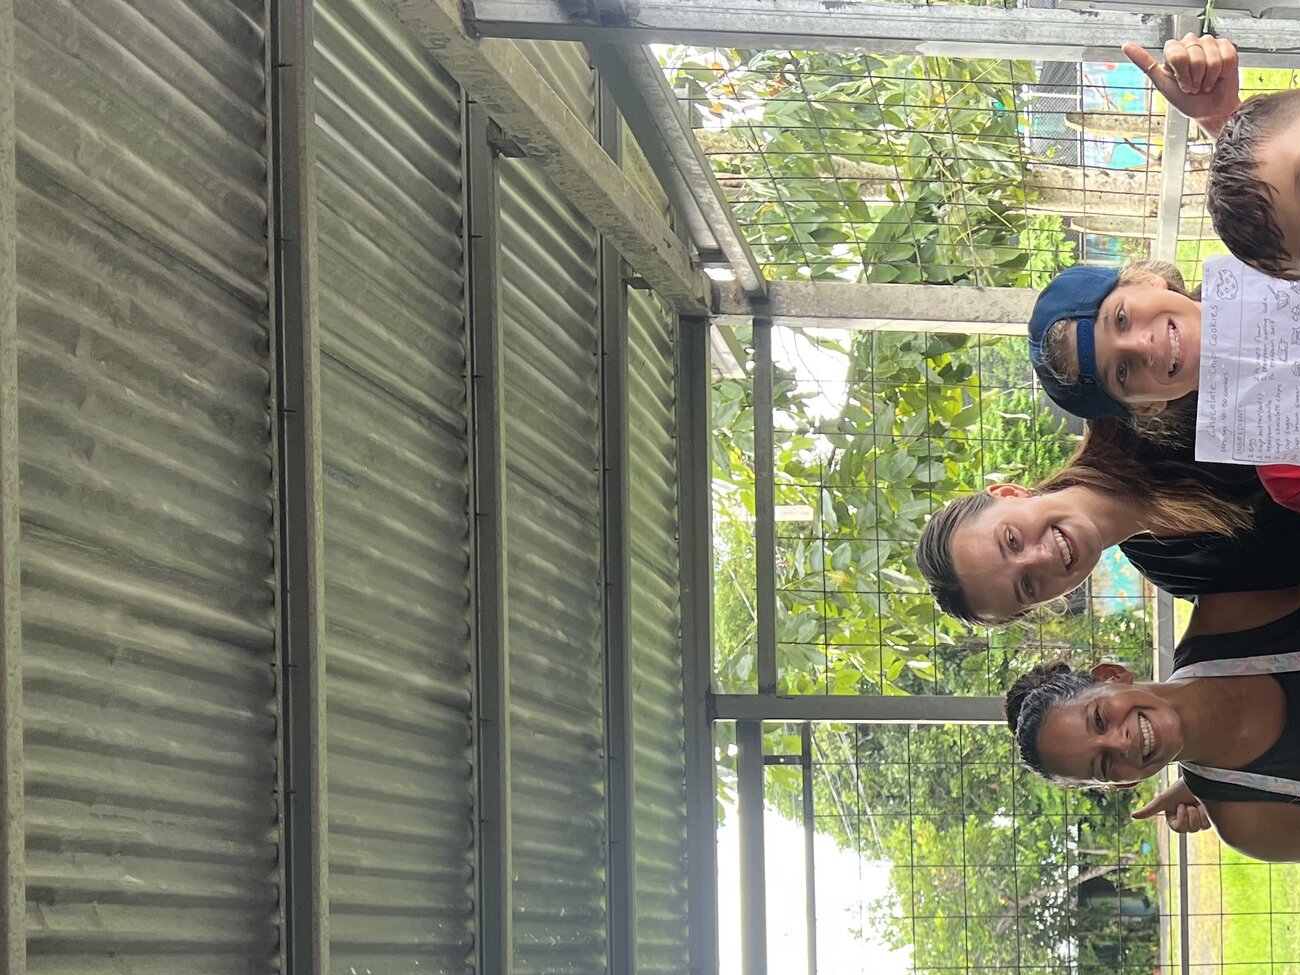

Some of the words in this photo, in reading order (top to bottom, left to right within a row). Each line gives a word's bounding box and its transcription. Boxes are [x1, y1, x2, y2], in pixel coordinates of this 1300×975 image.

[1208, 304, 1218, 347] Cookies
[1205, 383, 1217, 438] Chocolate
[1248, 438, 1257, 452] egg
